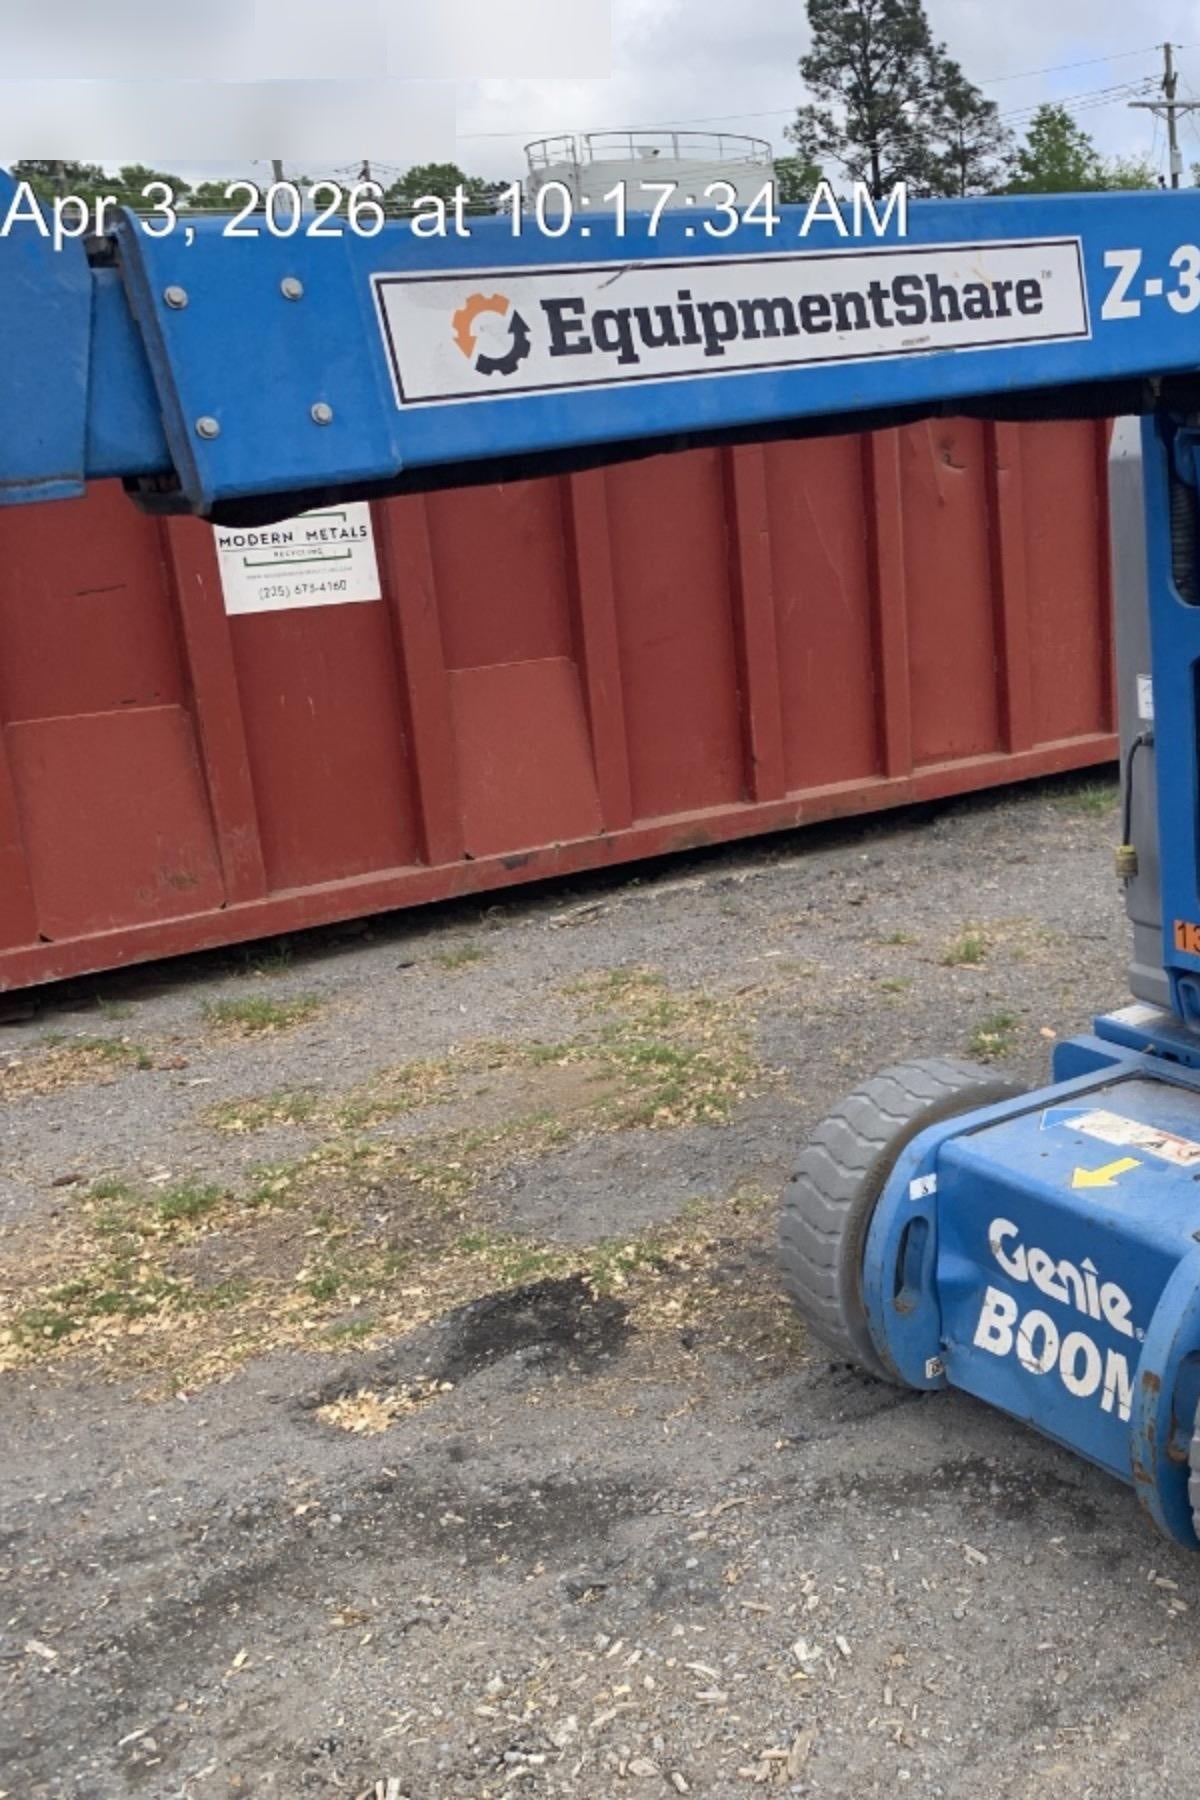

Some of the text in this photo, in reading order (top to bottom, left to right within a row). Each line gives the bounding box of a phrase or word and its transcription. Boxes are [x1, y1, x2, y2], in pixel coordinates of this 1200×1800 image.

[540, 273, 1043, 365] EquipmentShare
[219, 525, 368, 548] MODERN METALS
[988, 1217, 1134, 1338] Genie
